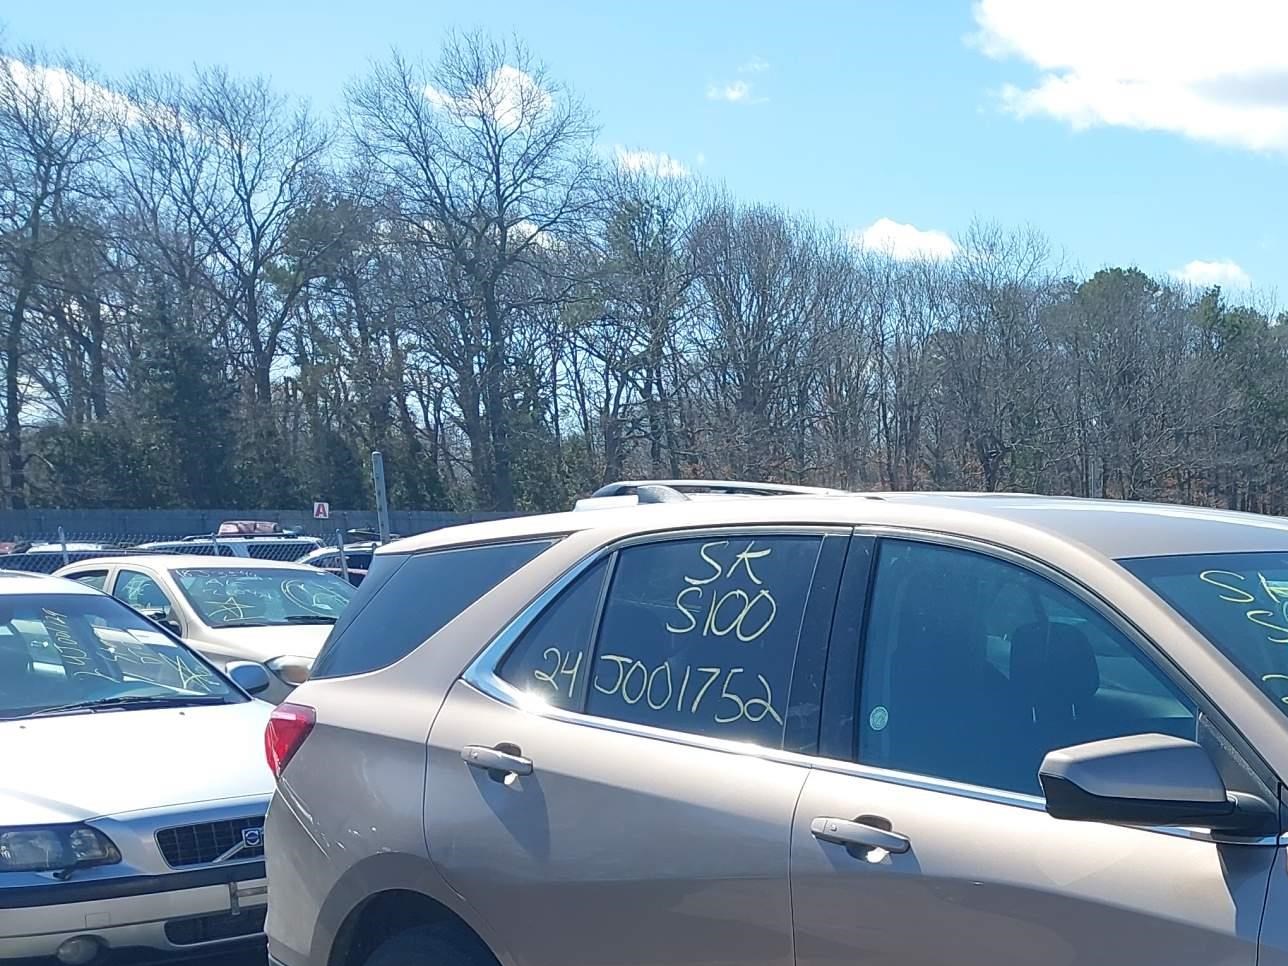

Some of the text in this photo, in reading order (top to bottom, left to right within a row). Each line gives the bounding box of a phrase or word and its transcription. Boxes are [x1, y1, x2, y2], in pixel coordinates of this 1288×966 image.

[314, 503, 328, 518] A
[666, 587, 776, 641] S100
[535, 648, 784, 726] 24 J001752
